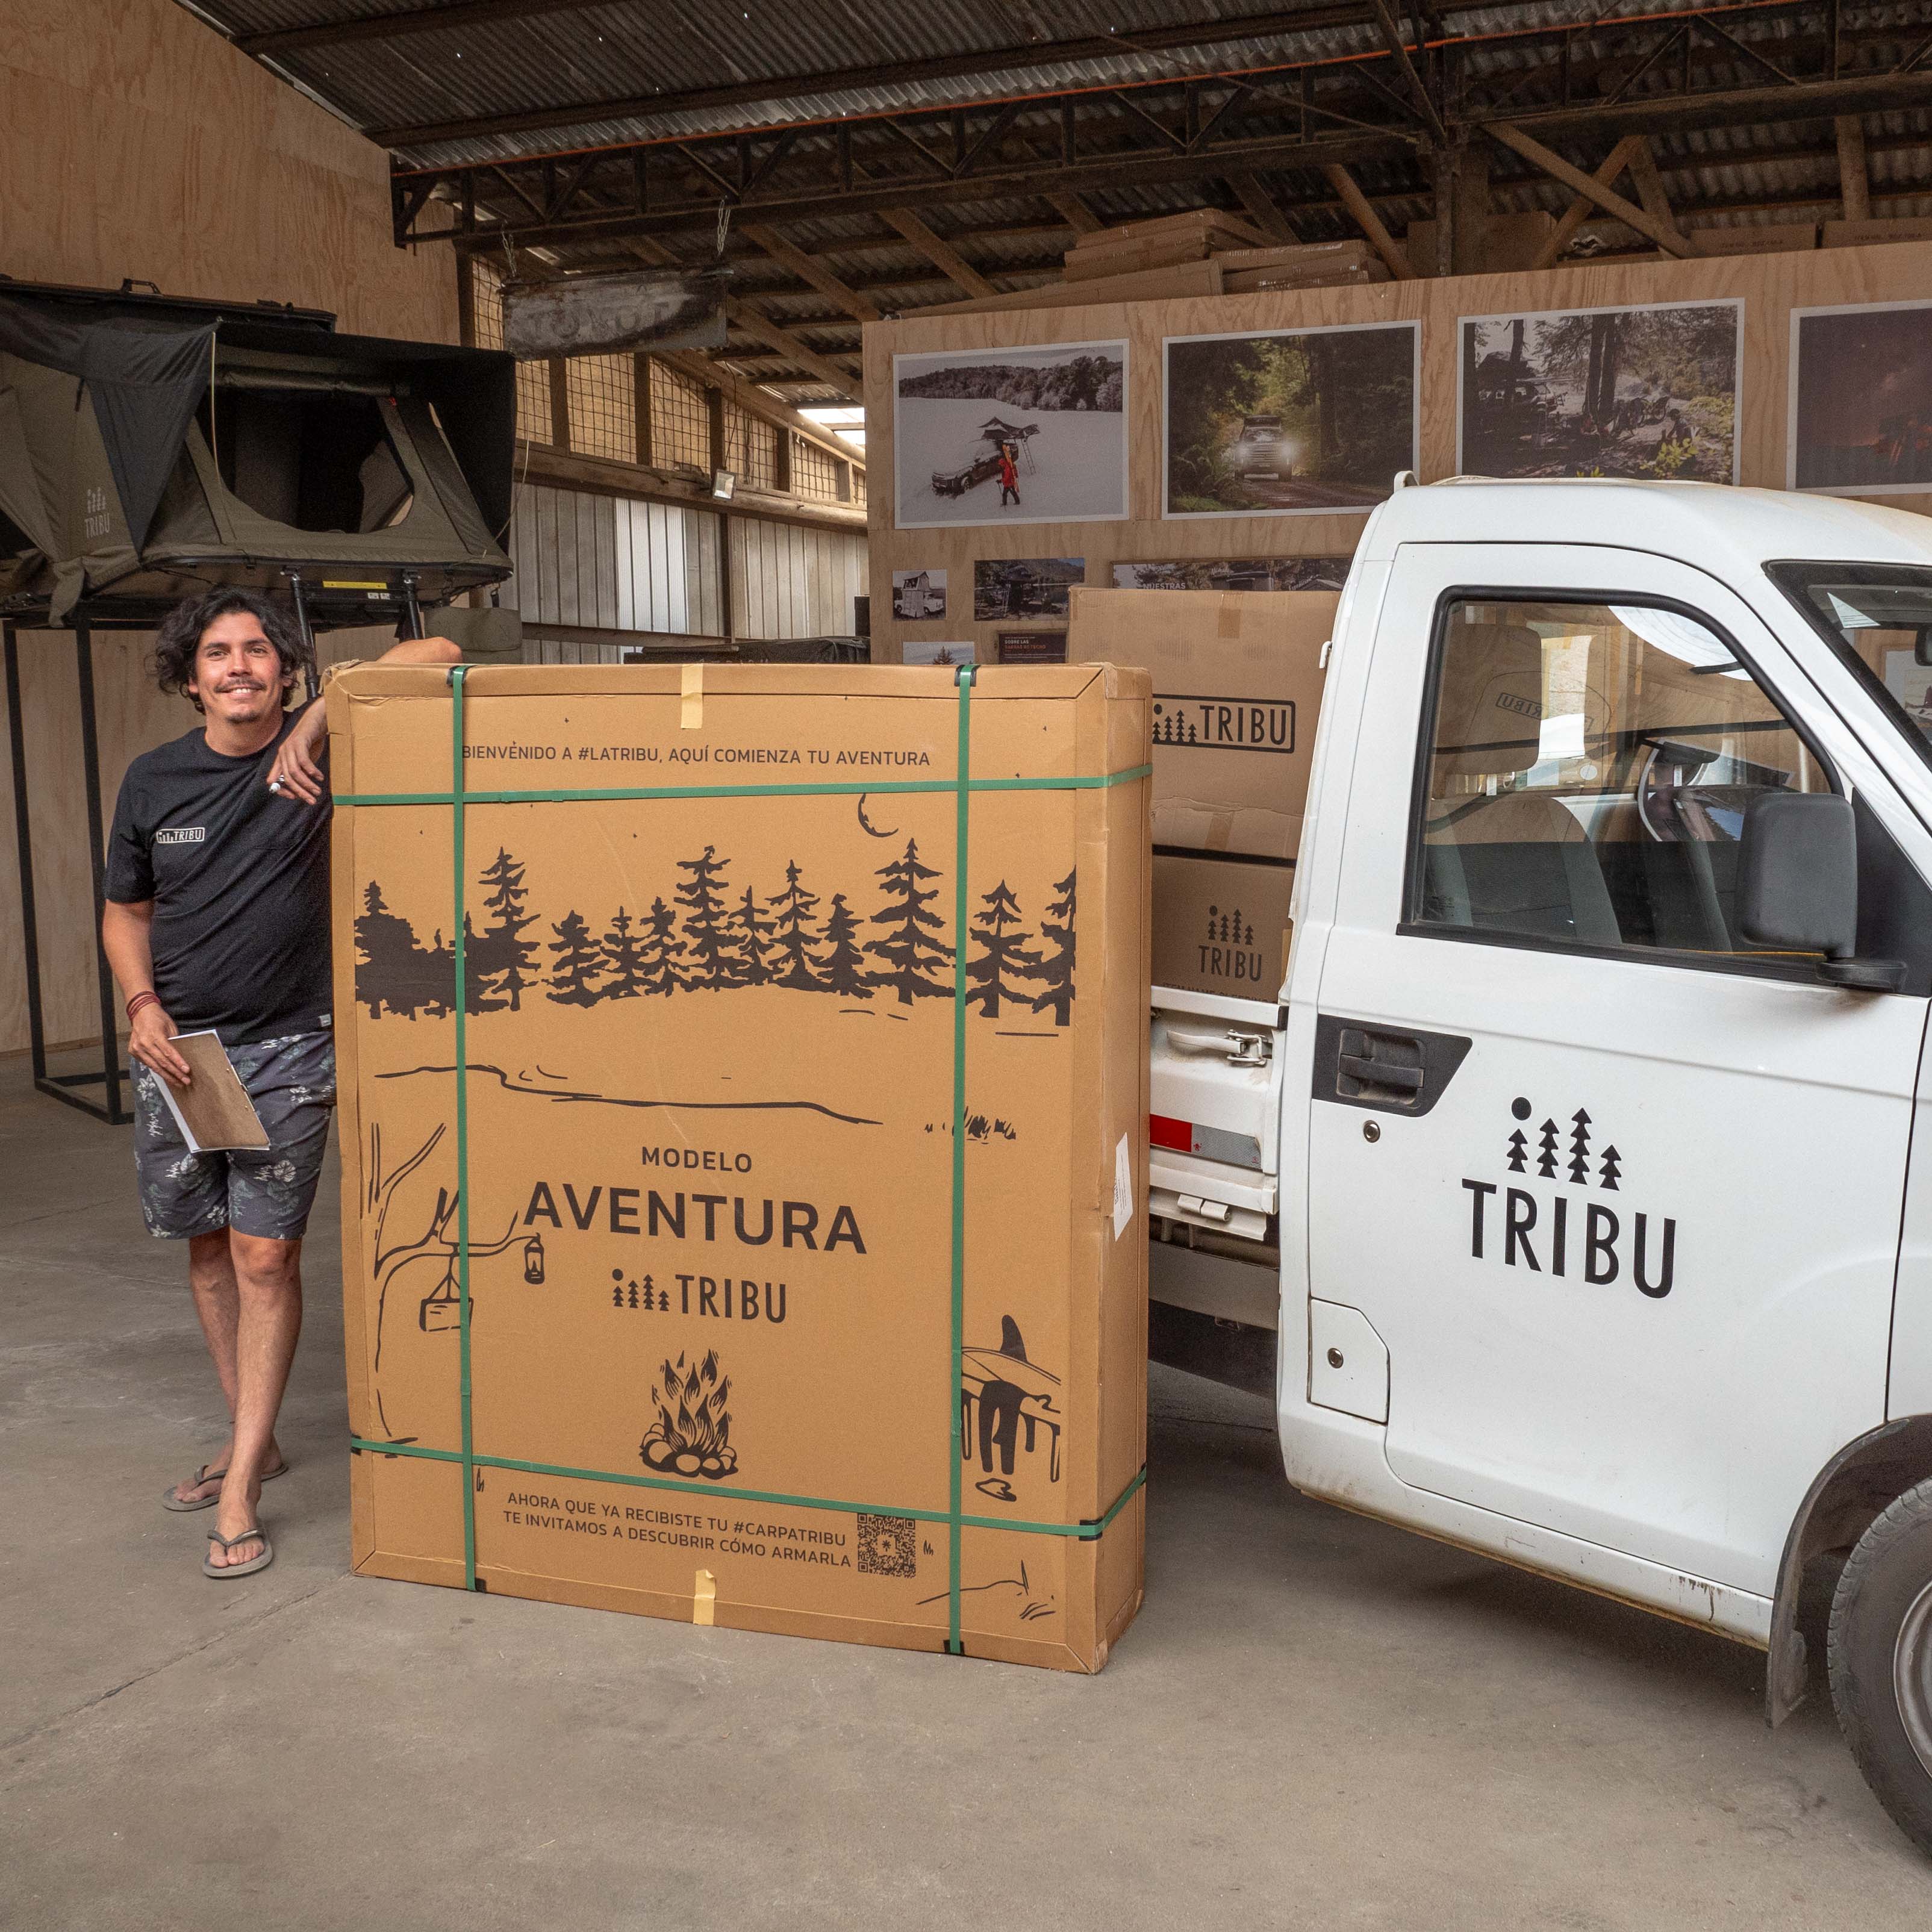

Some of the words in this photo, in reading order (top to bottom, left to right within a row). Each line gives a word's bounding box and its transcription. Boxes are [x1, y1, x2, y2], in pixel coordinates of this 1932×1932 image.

[84, 513, 110, 540] TRIBU
[1199, 704, 1287, 746] TRIBU
[562, 747, 572, 760] A
[578, 747, 662, 764] #LATRIBU,
[668, 745, 709, 765] AQUÍ
[714, 749, 801, 764] COMIENZA
[807, 750, 829, 764] TU
[836, 751, 930, 766] AVENTURA
[173, 829, 202, 841] TRIBU
[1198, 945, 1262, 982] TRIBU
[642, 1146, 752, 1173] MODELO
[523, 1181, 867, 1254] AVENTURA
[1461, 1178, 1676, 1299] TRIBU
[675, 1274, 786, 1324] TRIBU
[503, 1510, 521, 1525] TE
[526, 1513, 607, 1536] INVITAMOS
[612, 1525, 623, 1538] A
[628, 1527, 714, 1550] DESCUBRIR
[720, 1535, 765, 1557] CÓMO
[771, 1546, 852, 1568] ARMARLA
[508, 1492, 560, 1510] AHORA
[565, 1500, 596, 1515] QUE
[601, 1504, 620, 1518] YA
[626, 1507, 702, 1528] RECIBISTE
[707, 1517, 728, 1532] TU
[734, 1521, 846, 1547] #CARPATRIBU
